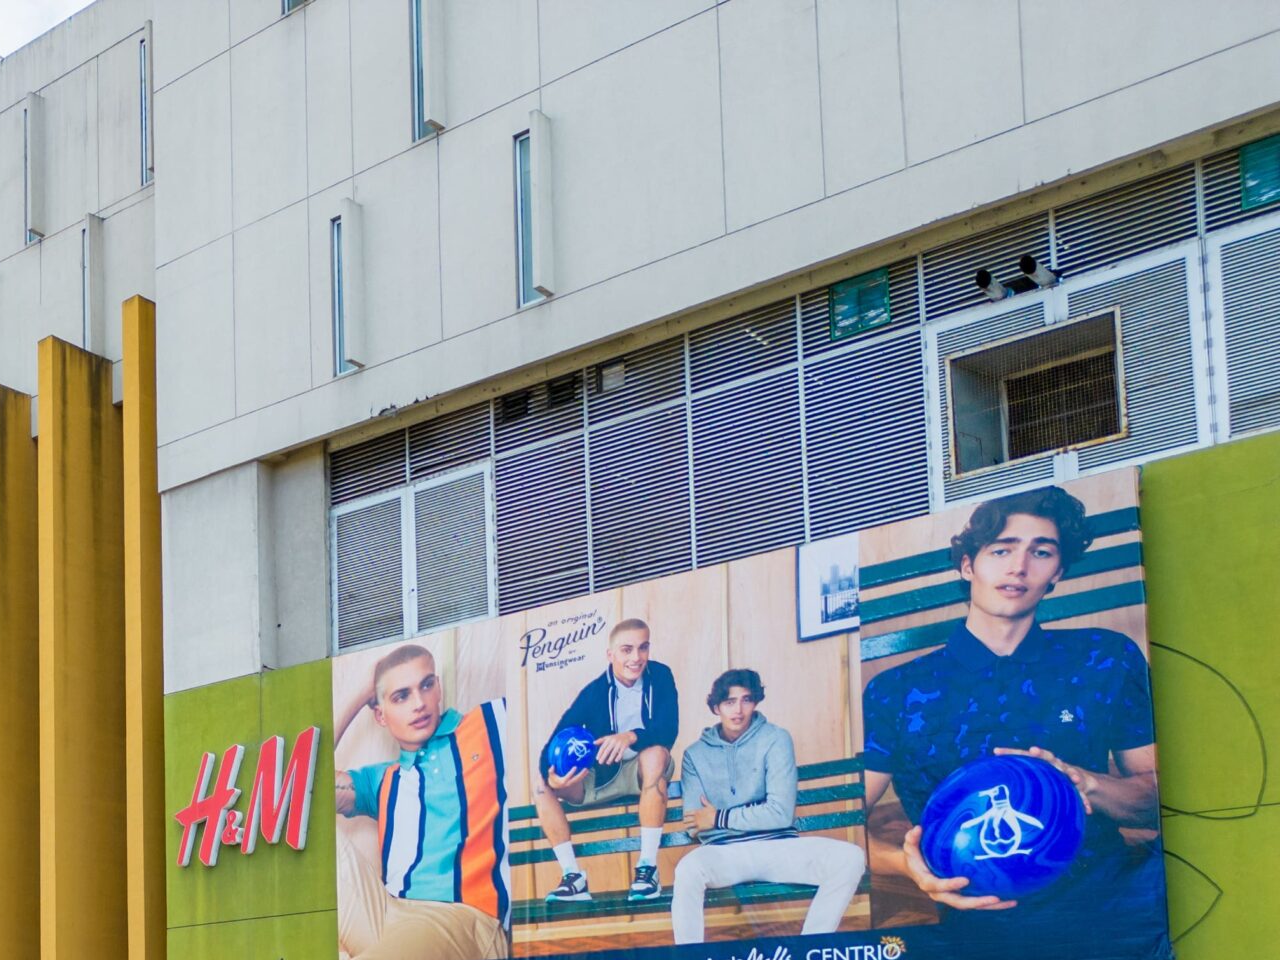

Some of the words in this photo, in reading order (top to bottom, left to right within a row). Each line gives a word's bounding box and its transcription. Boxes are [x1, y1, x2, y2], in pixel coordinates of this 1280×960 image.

[561, 609, 598, 626] original
[519, 622, 606, 668] Penguin
[174, 725, 320, 868] H&M
